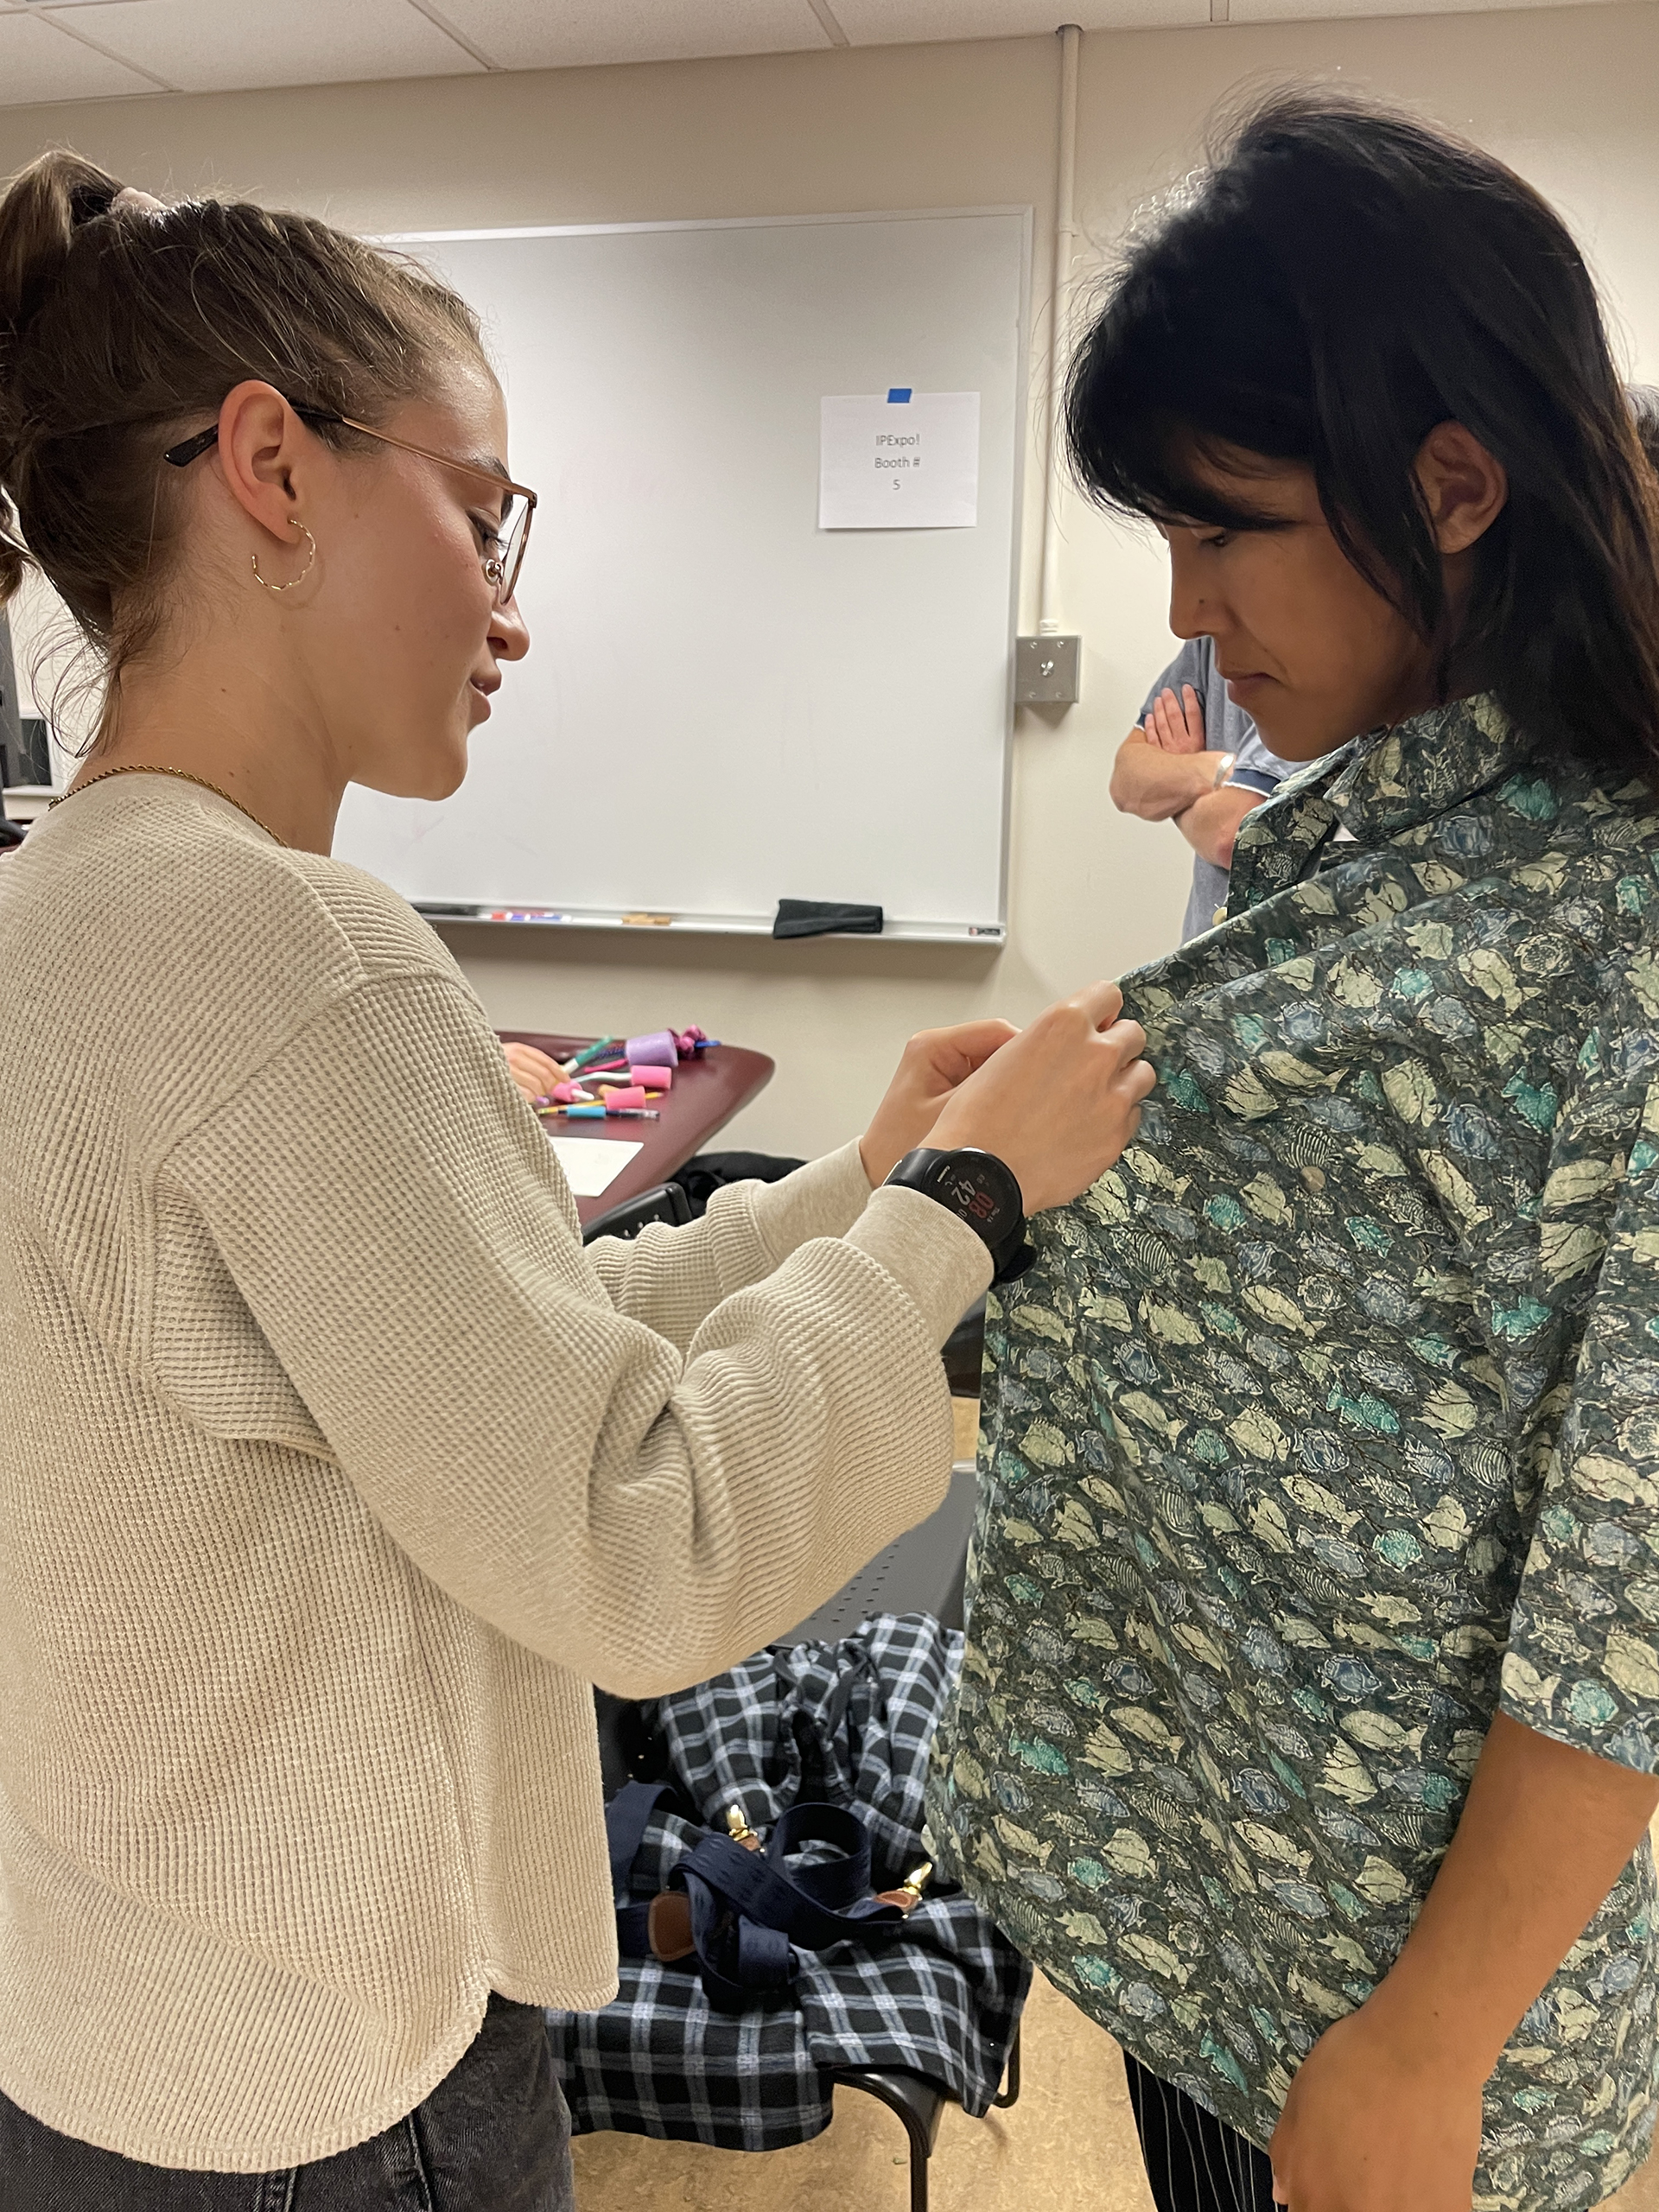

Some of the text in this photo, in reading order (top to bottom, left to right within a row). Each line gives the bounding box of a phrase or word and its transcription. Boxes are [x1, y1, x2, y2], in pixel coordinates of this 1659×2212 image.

[875, 434, 920, 448] IPExpo!
[874, 456, 920, 468] Booth #
[893, 479, 900, 490] 5
[951, 1179, 976, 1205] 42
